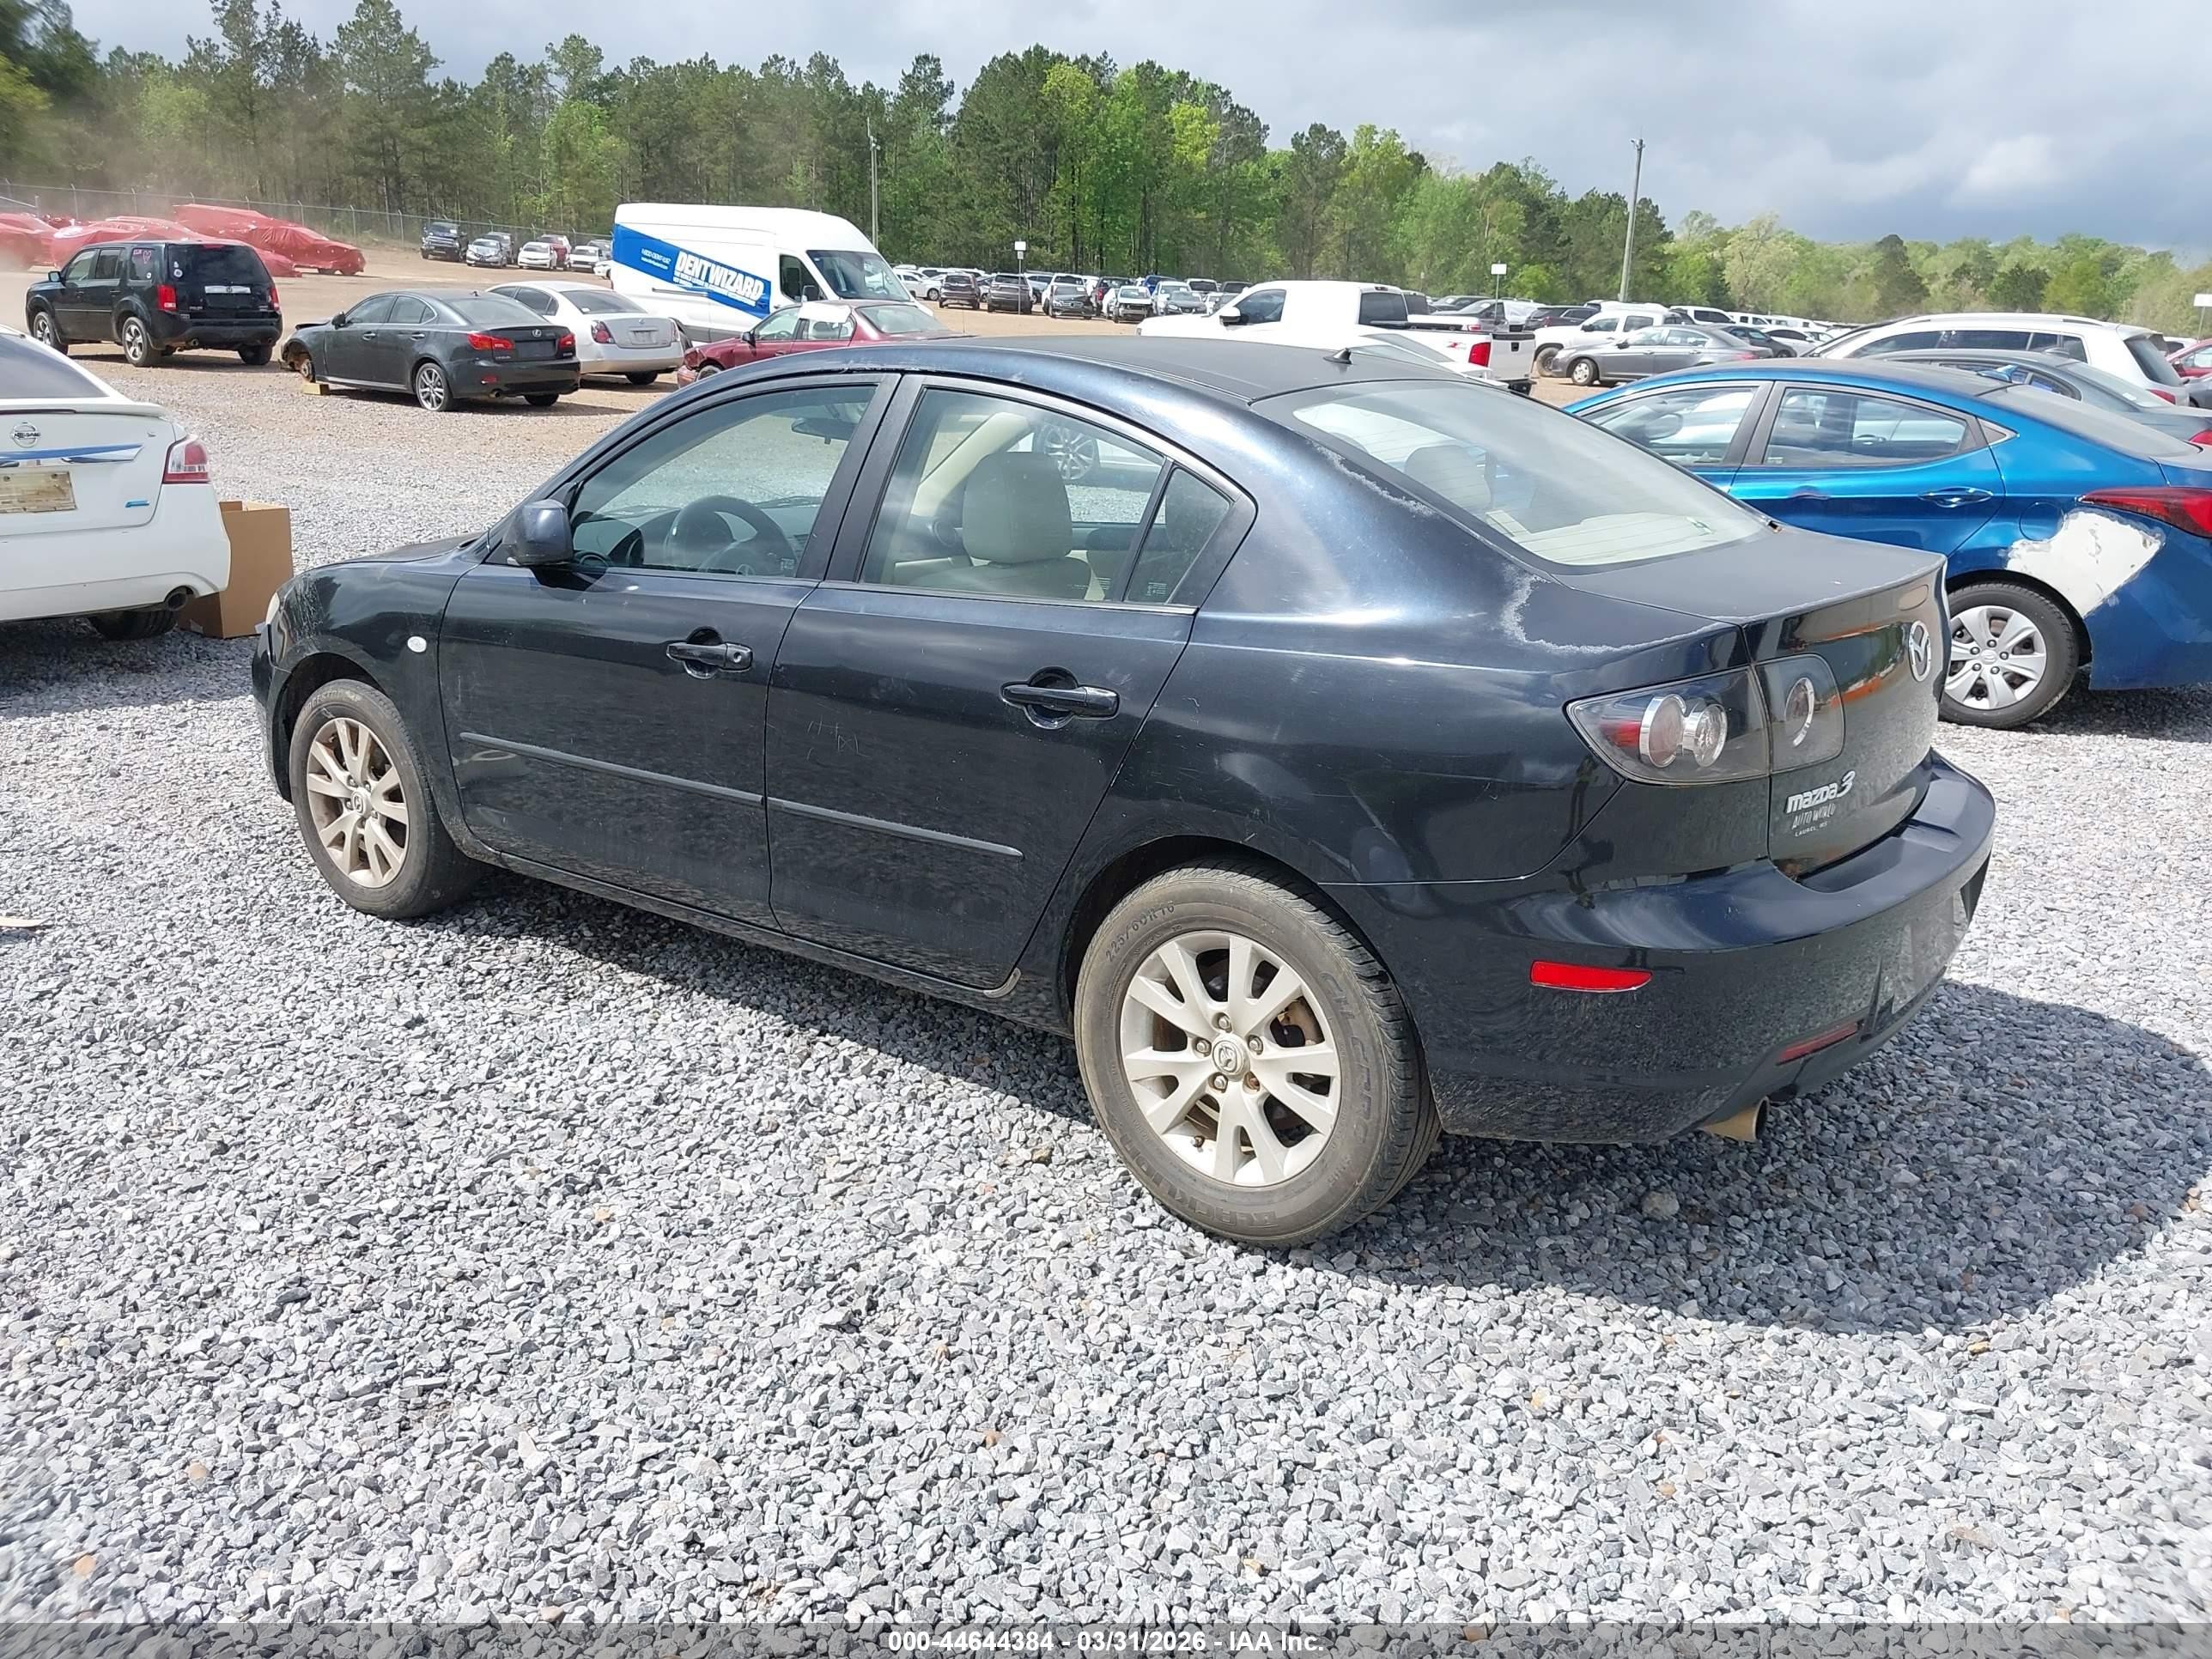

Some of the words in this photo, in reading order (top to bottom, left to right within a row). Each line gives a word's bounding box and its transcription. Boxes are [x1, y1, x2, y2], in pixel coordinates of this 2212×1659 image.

[674, 251, 711, 281] DENT
[709, 261, 765, 301] WIZARD
[1791, 810, 1813, 830] AUTO
[1813, 803, 1836, 821] WORLD
